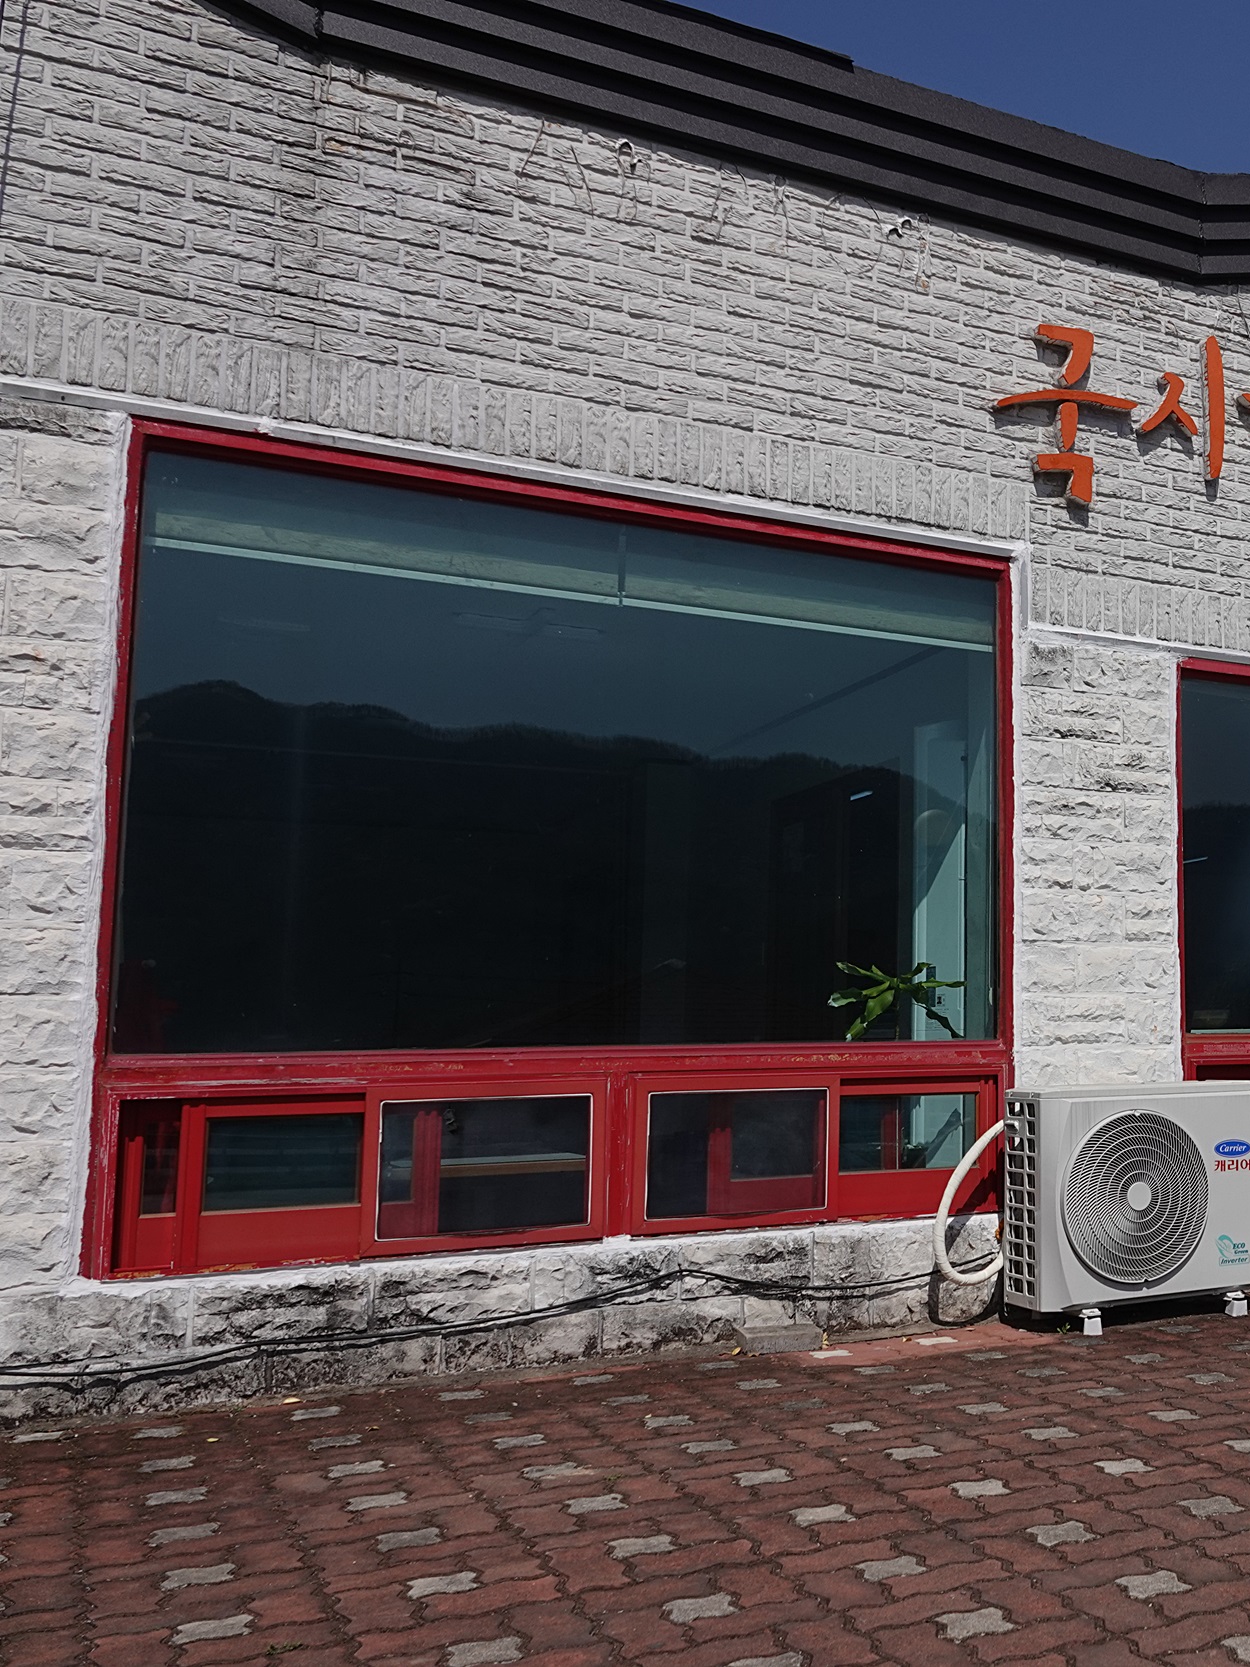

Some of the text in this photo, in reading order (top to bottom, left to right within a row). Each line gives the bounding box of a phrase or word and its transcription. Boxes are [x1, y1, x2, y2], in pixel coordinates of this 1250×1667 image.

[1219, 1144, 1247, 1153] Carrier
[1232, 1242, 1246, 1250] ECO
[1220, 1256, 1248, 1264] Inverter
